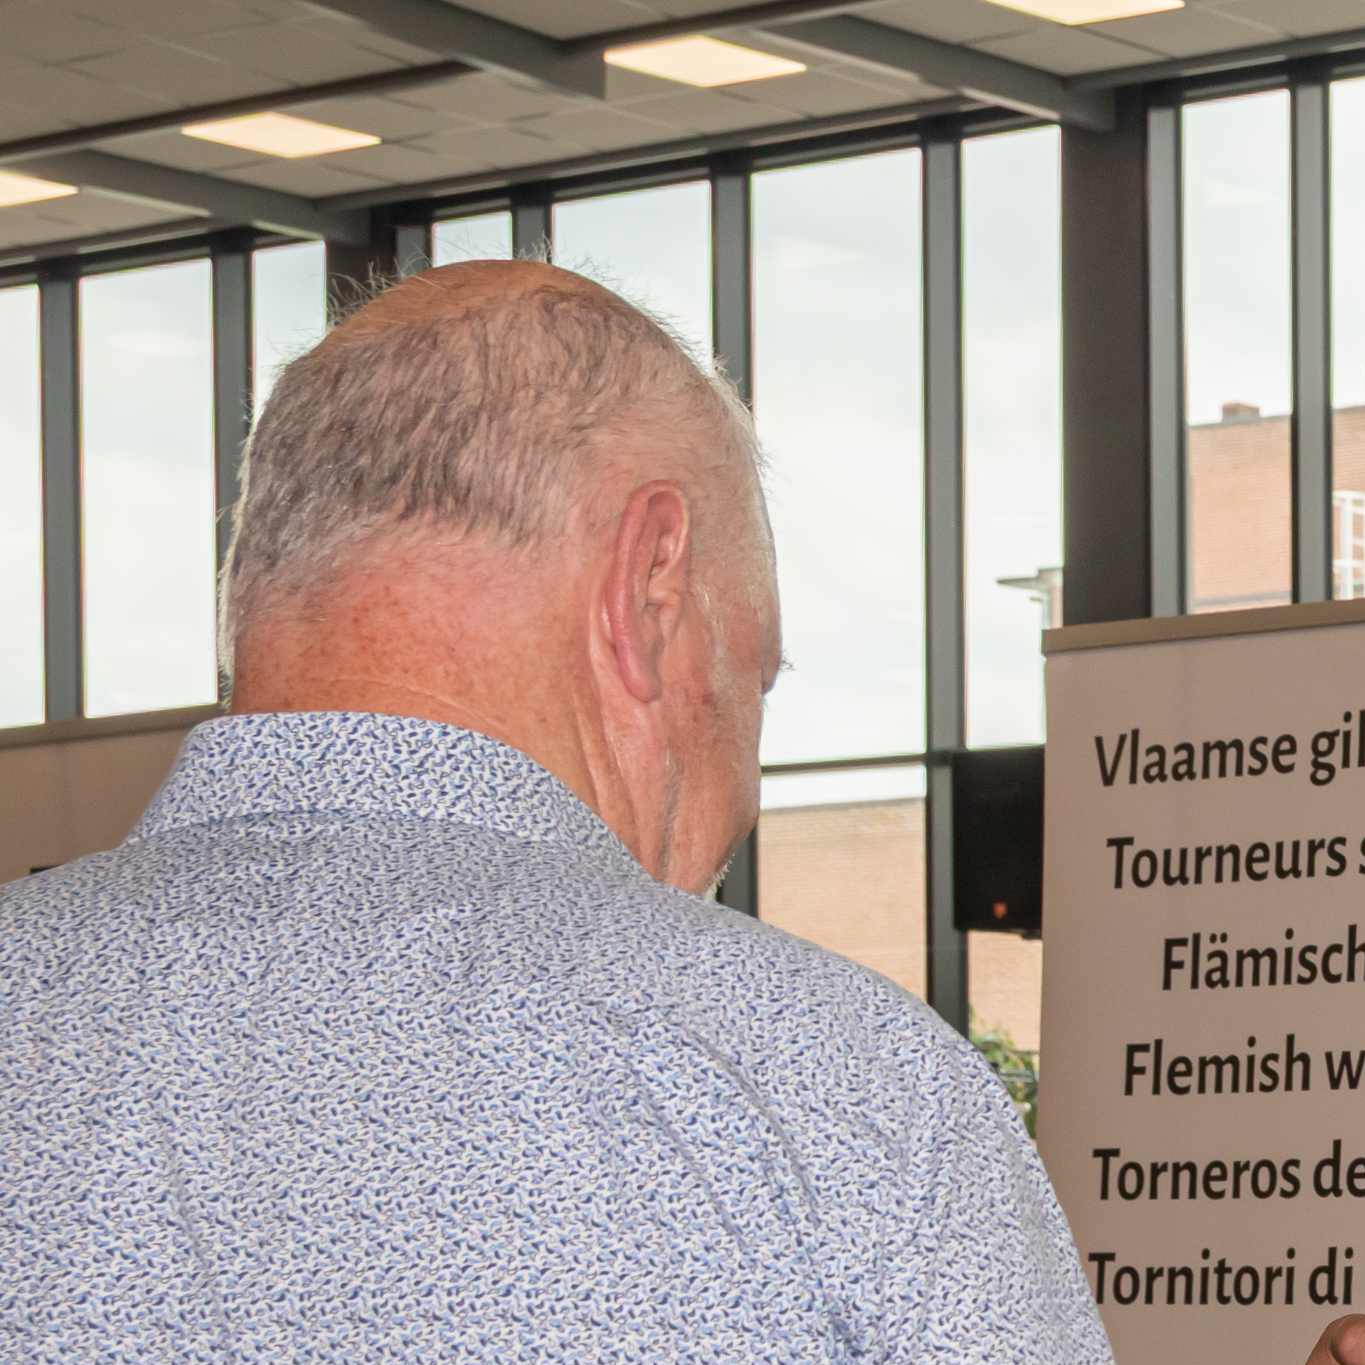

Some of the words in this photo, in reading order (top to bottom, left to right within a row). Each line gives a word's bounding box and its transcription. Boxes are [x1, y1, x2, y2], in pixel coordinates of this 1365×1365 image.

[1094, 727, 1298, 787] Vlaamse
[1106, 836, 1347, 889] Tourneurs
[1123, 1033, 1311, 1097] Flemish
[1092, 1147, 1301, 1201] Torneros
[1087, 1247, 1296, 1306] Tornitori
[1308, 1246, 1354, 1306] di
